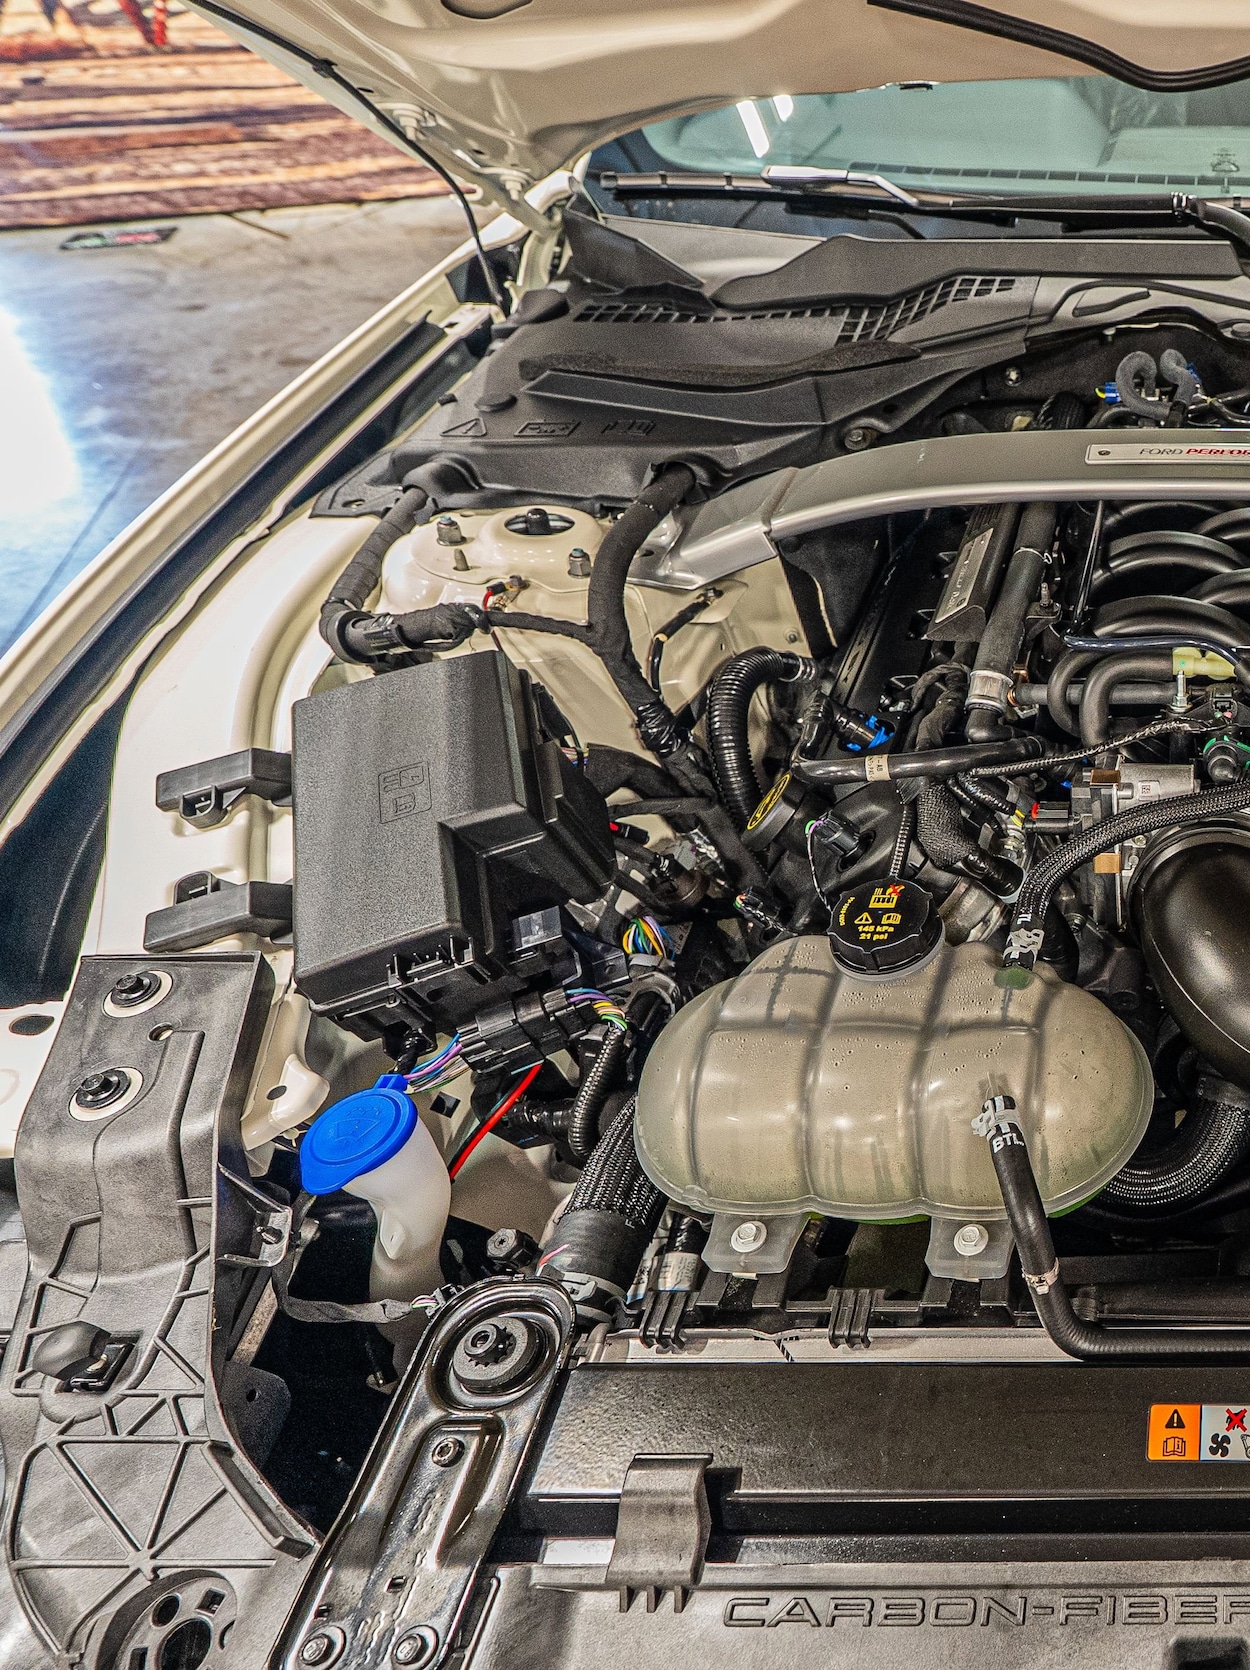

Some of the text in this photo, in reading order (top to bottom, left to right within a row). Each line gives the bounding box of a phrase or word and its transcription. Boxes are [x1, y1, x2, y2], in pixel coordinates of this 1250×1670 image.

[1138, 447, 1183, 456] FORD
[872, 933, 888, 941] psi
[992, 1132, 1025, 1154] BTL
